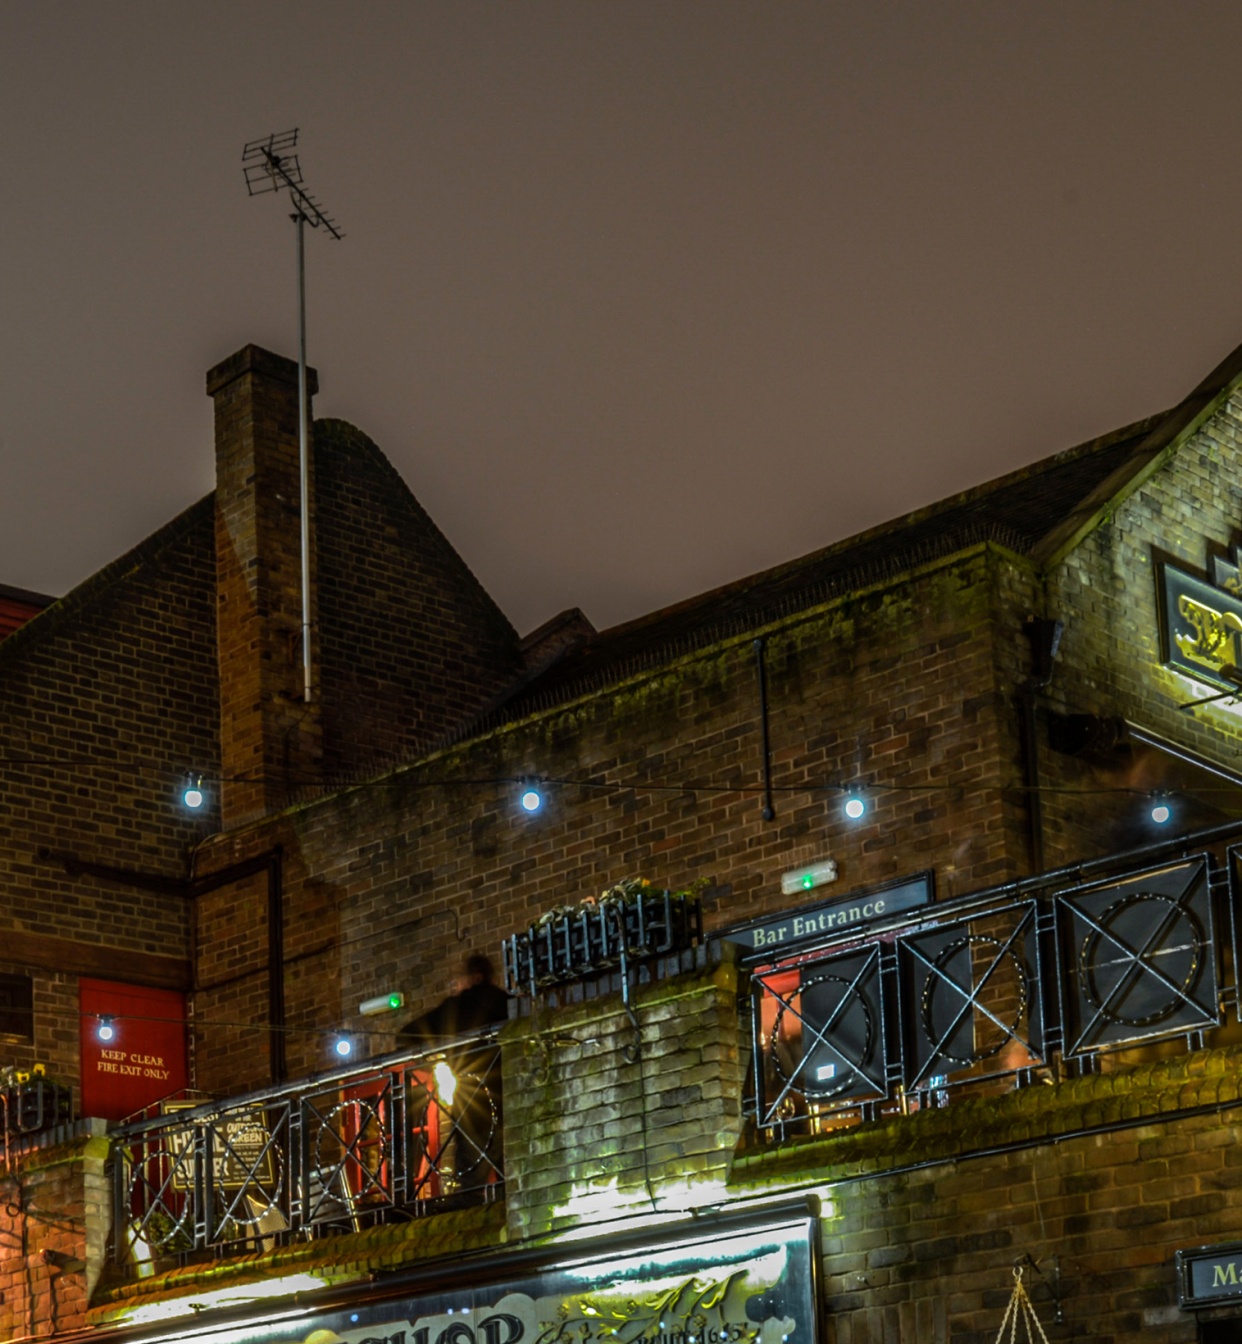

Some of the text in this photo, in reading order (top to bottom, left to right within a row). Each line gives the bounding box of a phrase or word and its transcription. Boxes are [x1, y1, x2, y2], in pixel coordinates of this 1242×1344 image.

[752, 900, 886, 948] Bar Entrance
[101, 1049, 164, 1067] KEEP CLEAR
[97, 1061, 170, 1080] FIRE EXIT ONLY
[1212, 1262, 1242, 1288] M
